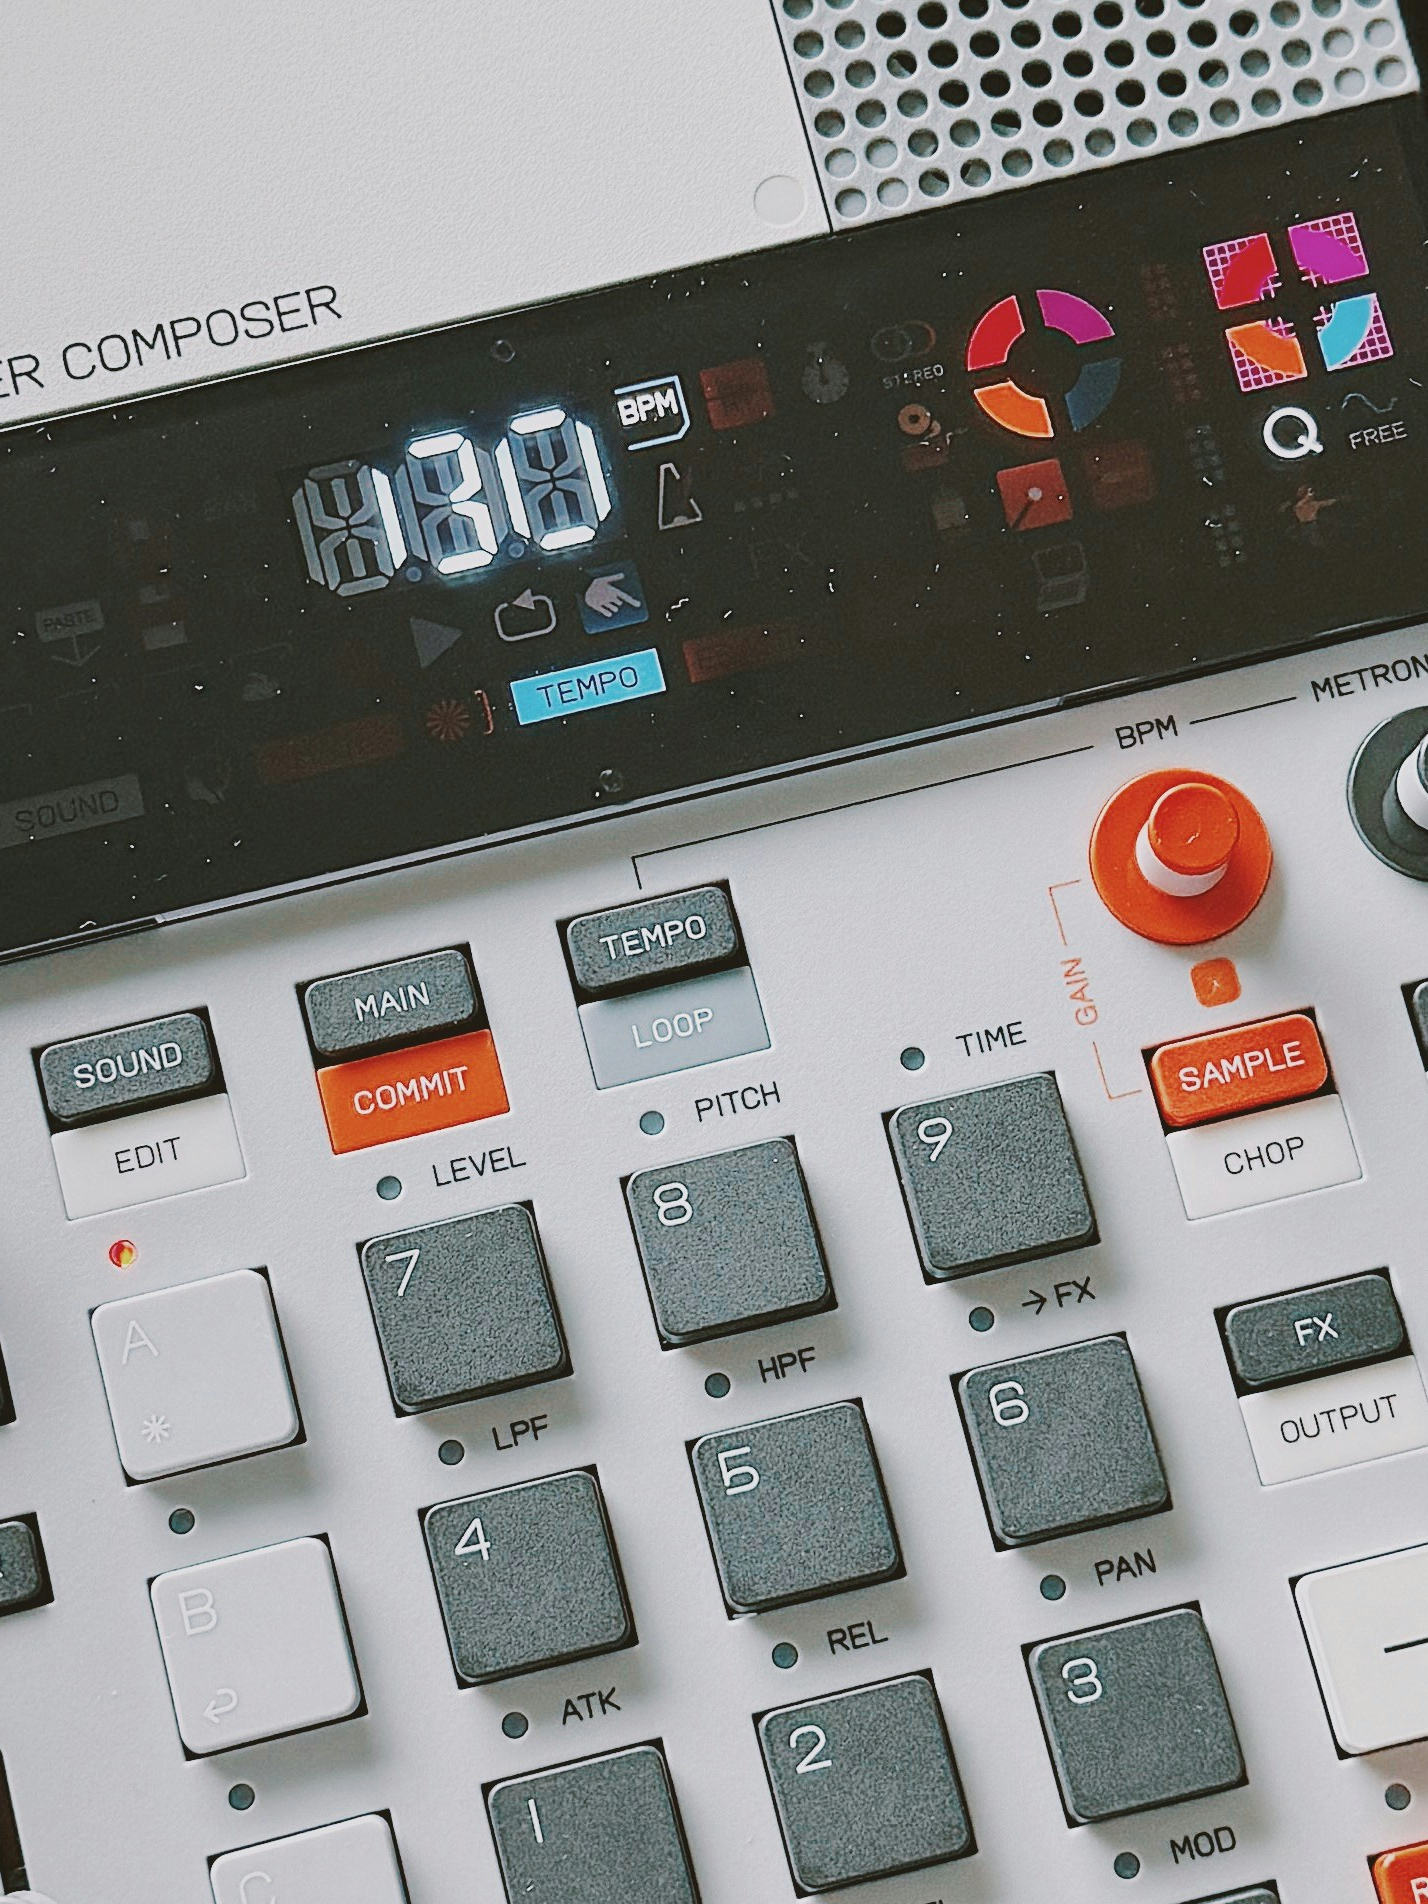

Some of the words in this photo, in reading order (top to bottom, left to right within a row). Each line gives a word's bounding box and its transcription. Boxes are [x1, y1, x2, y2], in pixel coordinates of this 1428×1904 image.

[62, 284, 342, 381] COMPOSER
[616, 388, 679, 427] BPM
[1349, 421, 1408, 452] FREE
[370, 407, 612, 575] 130
[536, 666, 640, 709] TEMPO
[1115, 716, 1179, 751] BPM
[14, 789, 121, 834] SOUND
[600, 914, 707, 961] TEMPO
[354, 980, 430, 1023] MAIN
[1061, 956, 1099, 1026] GAIN
[631, 1006, 713, 1049] LOOP
[956, 1021, 1027, 1058] TIME
[72, 1041, 183, 1090] SOUND
[1178, 1040, 1306, 1093] SAMPLE
[353, 1065, 468, 1116] COMMIT
[694, 1081, 781, 1123] PITCH
[114, 1135, 182, 1175] EDIT
[916, 1116, 953, 1162] 9
[1224, 1135, 1305, 1176] CHOP
[432, 1146, 527, 1188] LEVEL
[652, 1181, 693, 1227] 8
[384, 1248, 421, 1297] 7
[1054, 1276, 1096, 1308] FX
[120, 1319, 159, 1365] A
[1293, 1313, 1339, 1347] FX
[757, 1347, 817, 1384] HPF
[988, 1381, 1030, 1428] 6
[1280, 1394, 1398, 1445] OUTPUT
[491, 1414, 548, 1452] LPF
[716, 1447, 760, 1496] 5
[454, 1517, 491, 1561] 4
[1094, 1548, 1158, 1587] PAN
[177, 1587, 218, 1636] B
[827, 1621, 889, 1656] REL
[1060, 1657, 1103, 1705] 3
[561, 1687, 622, 1726] ATK
[788, 1725, 833, 1775] 2
[1169, 1825, 1237, 1866] MOD
